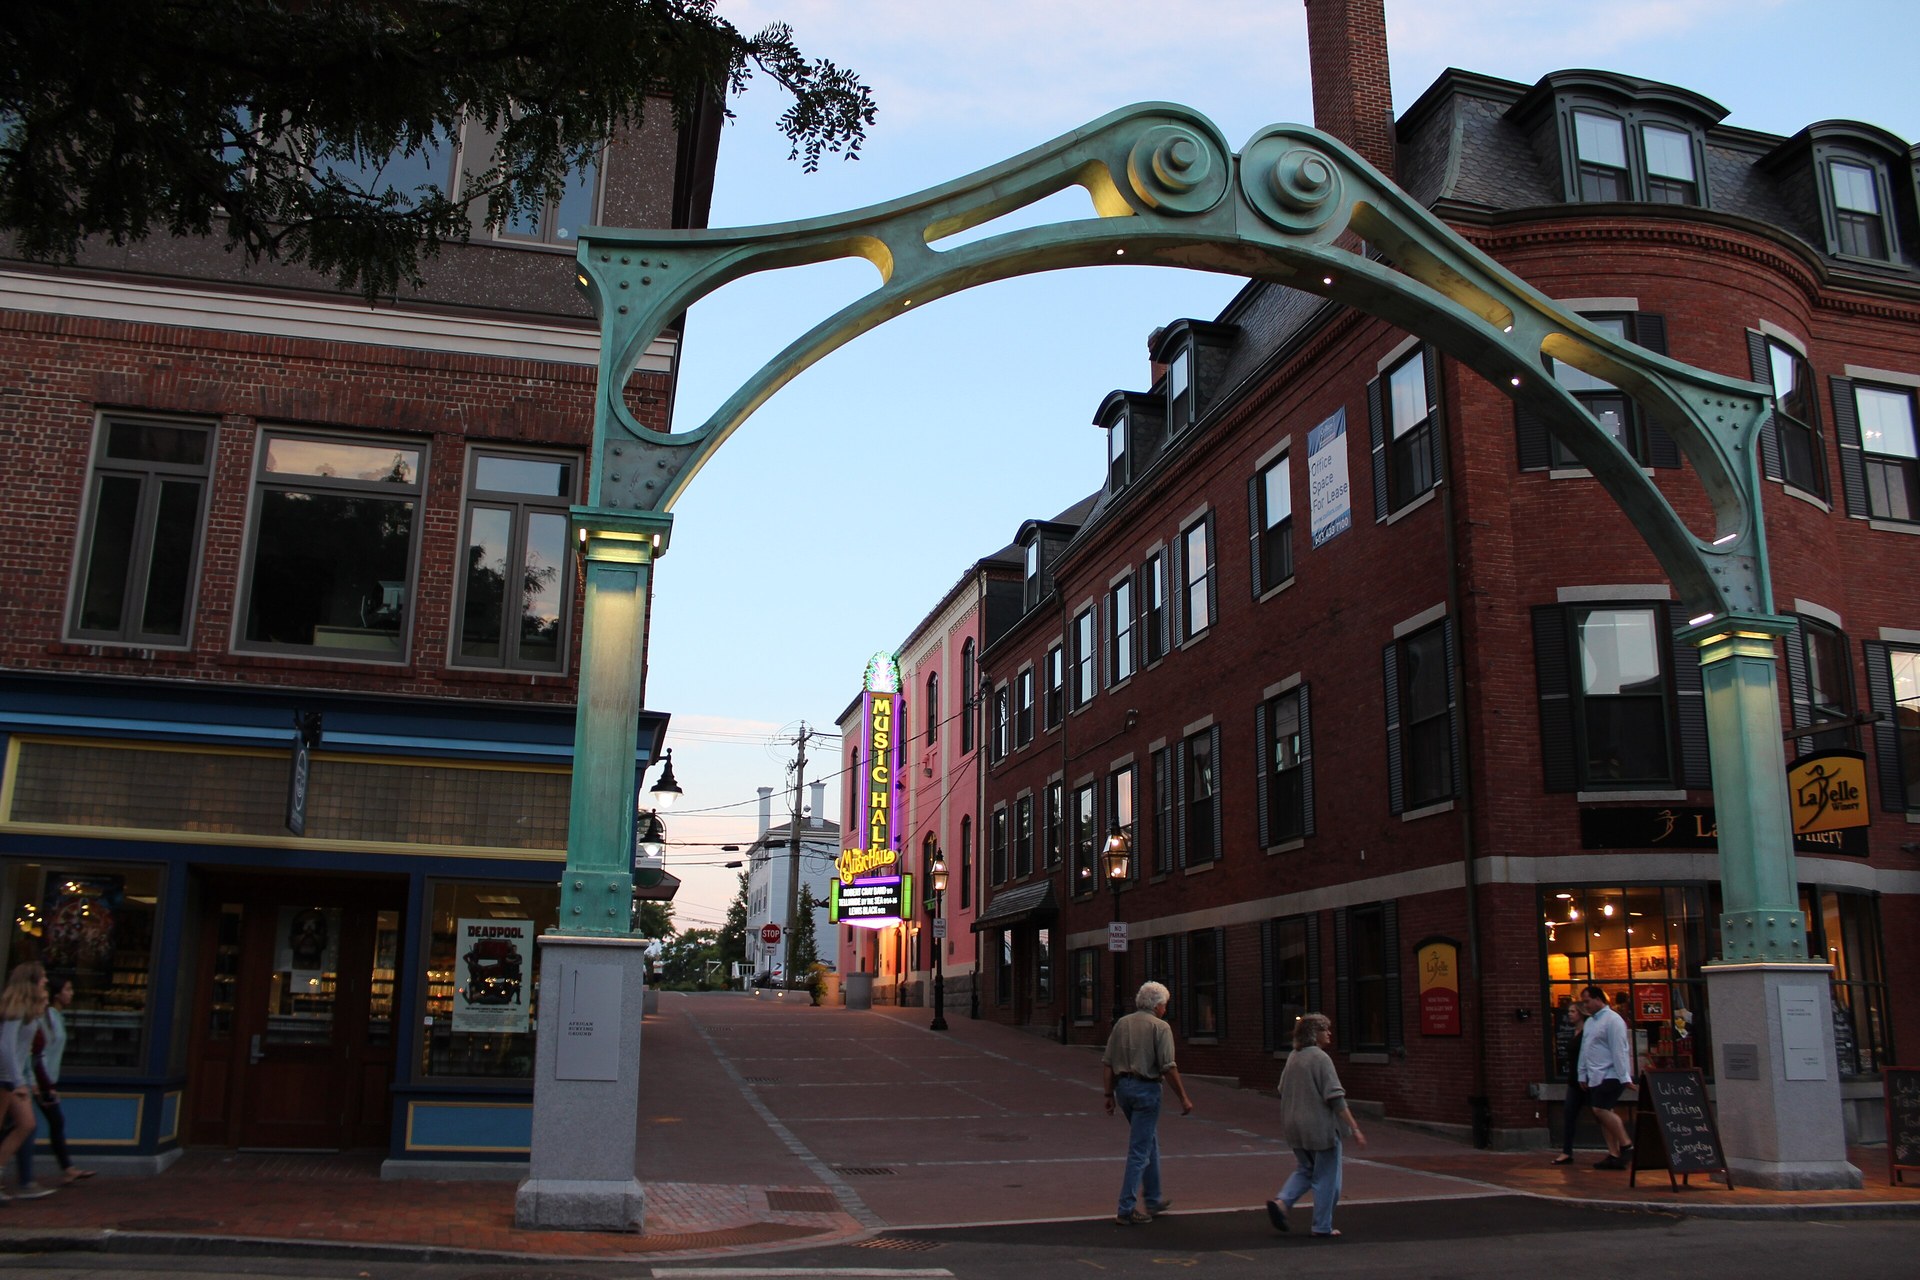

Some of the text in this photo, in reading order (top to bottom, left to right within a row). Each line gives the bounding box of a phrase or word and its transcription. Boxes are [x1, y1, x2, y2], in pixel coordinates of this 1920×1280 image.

[1311, 455, 1332, 477] Office
[1312, 473, 1334, 496] Space
[1312, 482, 1348, 513] For Lease
[872, 699, 891, 784] MUSIC
[1831, 802, 1859, 811] Winery
[467, 926, 524, 938] DEADPOOL
[762, 930, 780, 938] STOP
[1657, 1082, 1694, 1096] Wine
[1661, 1101, 1703, 1119] Tasting
[1666, 1121, 1692, 1136] Today
